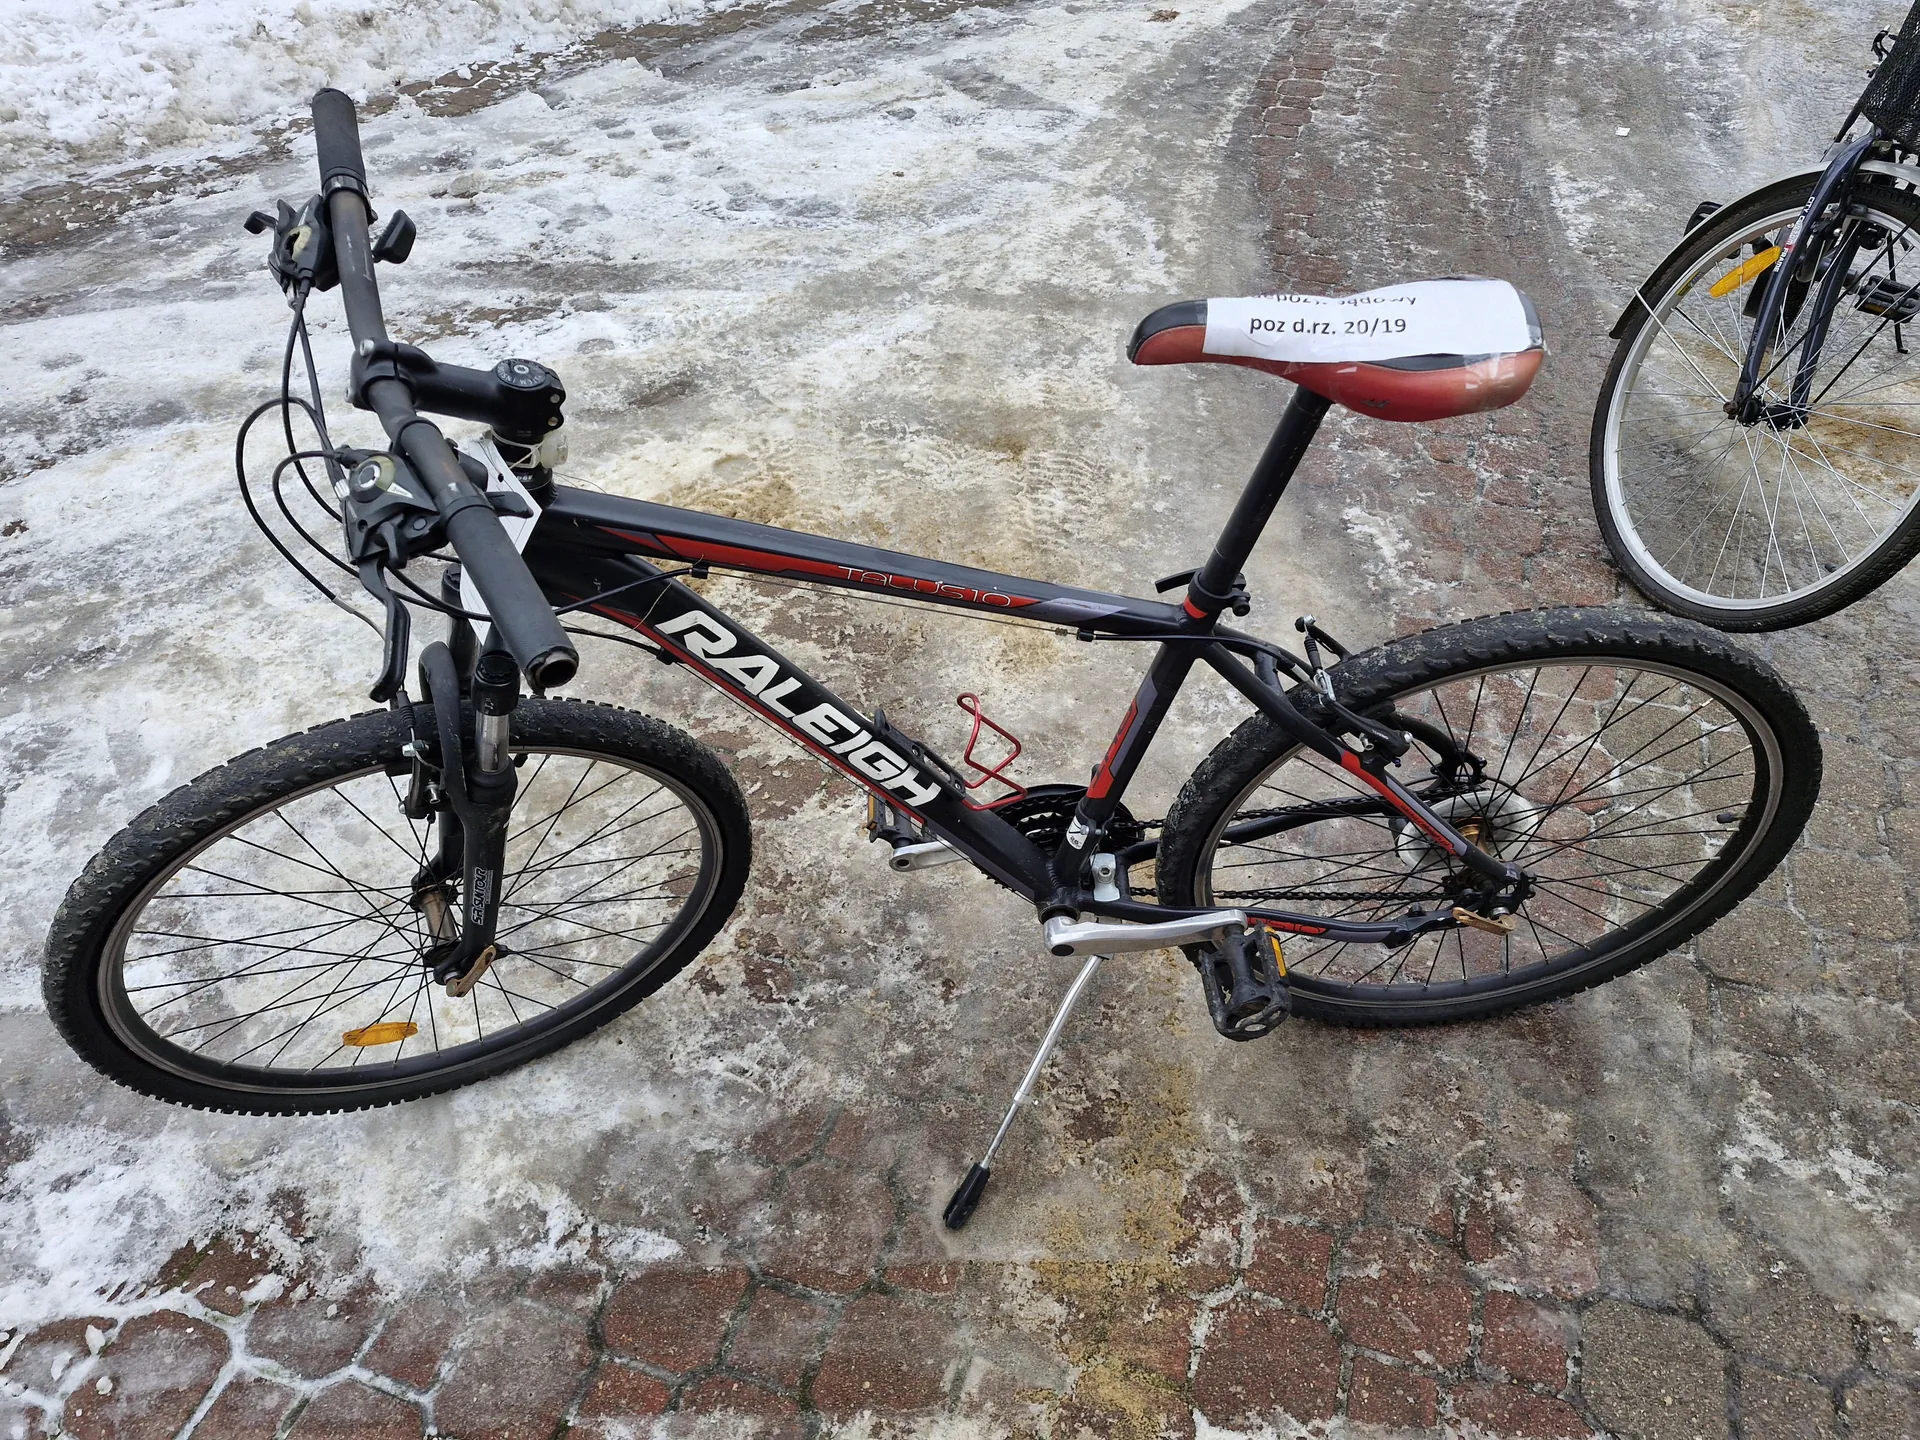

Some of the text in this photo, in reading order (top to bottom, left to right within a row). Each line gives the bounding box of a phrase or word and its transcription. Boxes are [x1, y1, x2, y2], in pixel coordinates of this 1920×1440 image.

[1250, 318, 1407, 337] poz d.rz. 20/19
[655, 610, 942, 807] RALEIGH
[472, 867, 488, 908] SUNTOUR
